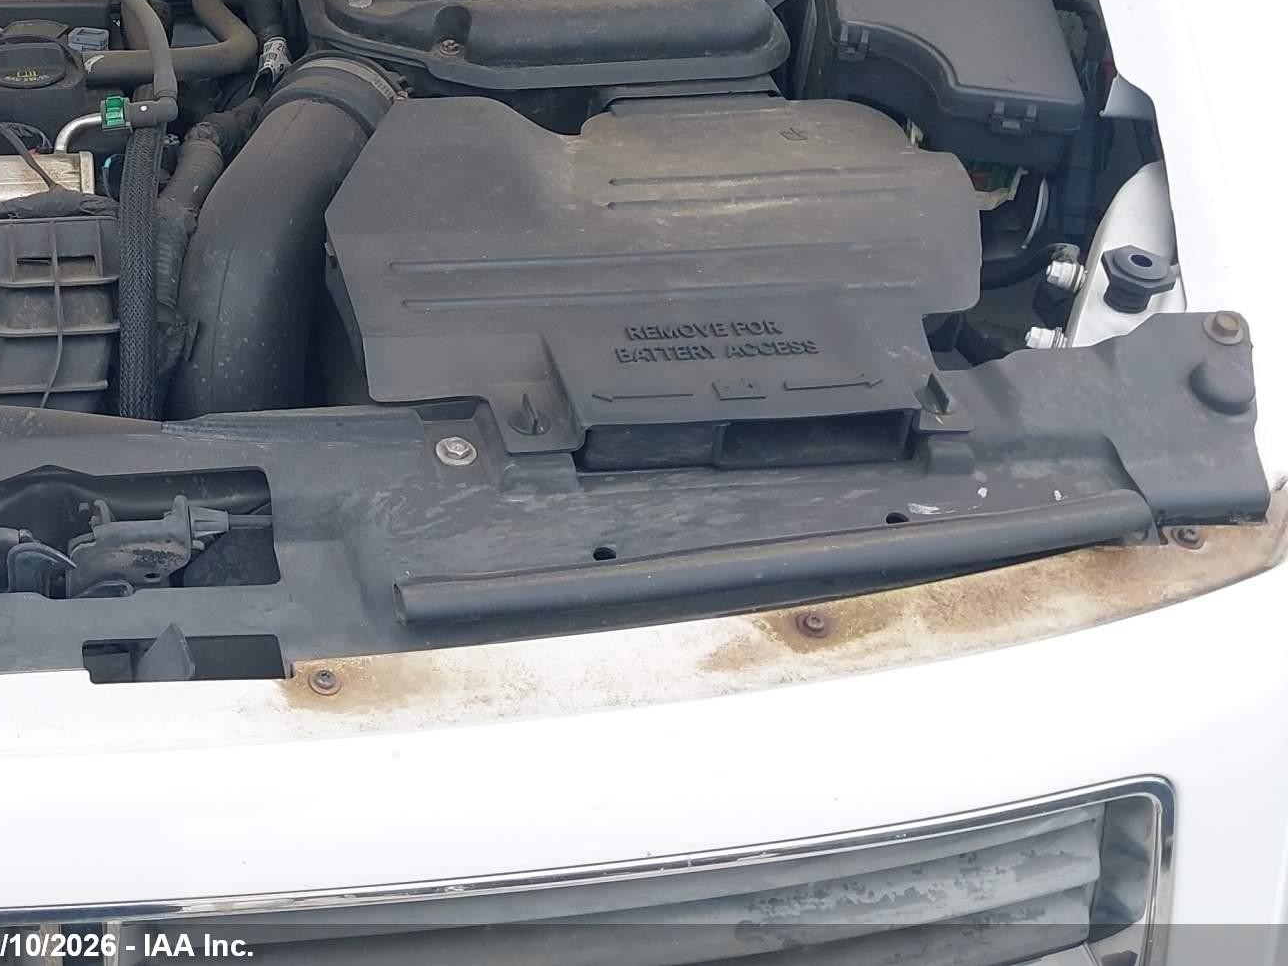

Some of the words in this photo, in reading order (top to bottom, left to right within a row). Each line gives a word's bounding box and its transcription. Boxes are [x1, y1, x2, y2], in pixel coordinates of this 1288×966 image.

[626, 321, 726, 342] REMOVE
[731, 319, 783, 338] FOR
[615, 345, 716, 364] BATTERY
[726, 339, 820, 359] ACCESS
